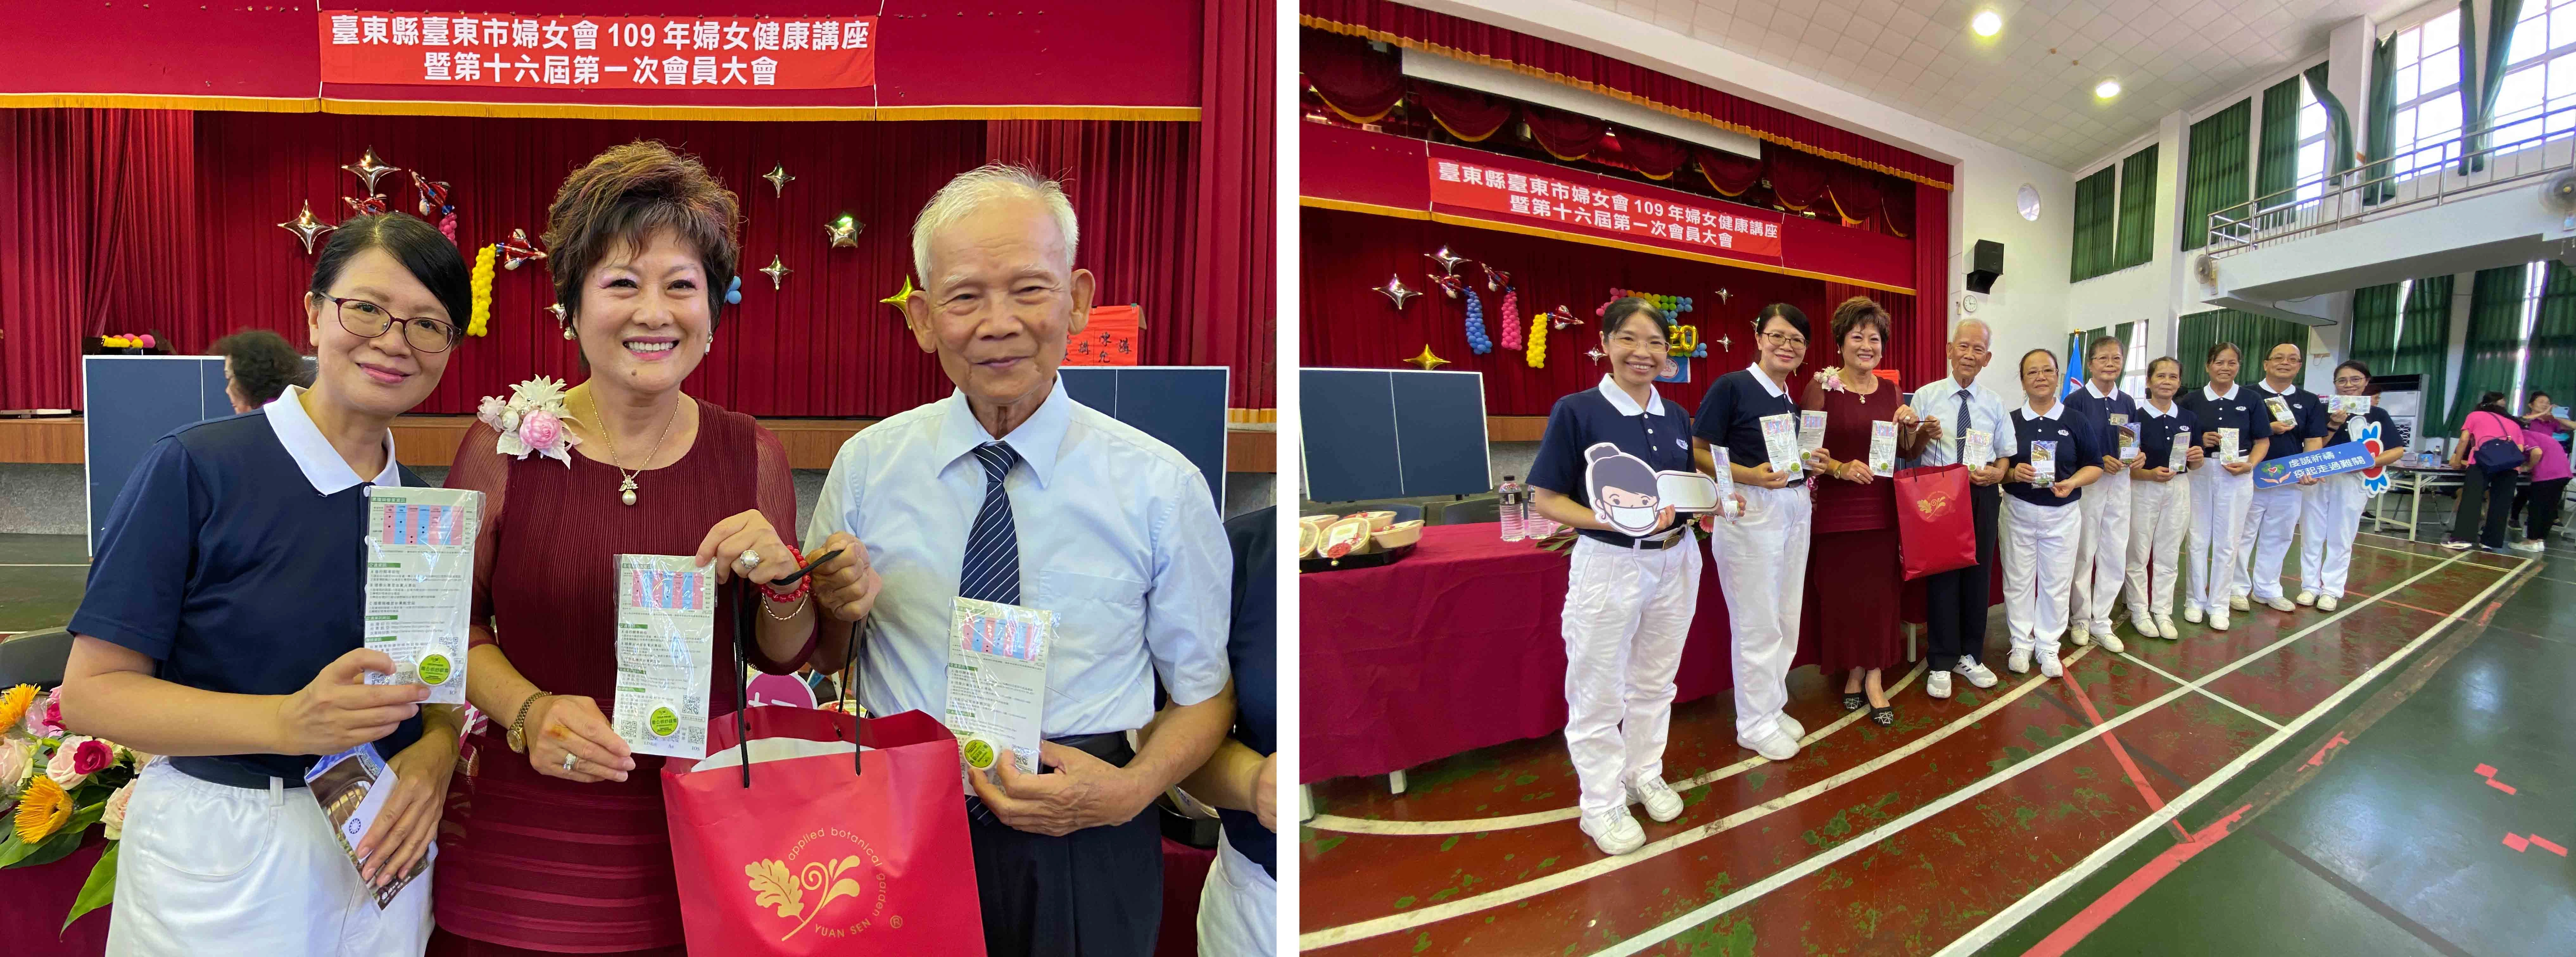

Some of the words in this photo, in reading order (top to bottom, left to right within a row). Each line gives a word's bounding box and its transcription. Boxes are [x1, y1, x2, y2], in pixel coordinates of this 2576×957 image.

[331, 15, 599, 50] 臺東縣臺東市婦女會
[608, 23, 655, 47] 109
[663, 20, 869, 51] 年婦女健康講座
[424, 52, 778, 85] 暨第十六屆第一次會員大會
[1438, 162, 1629, 212] 臺東縣臺東市婦女會
[1635, 199, 1663, 216] 109
[1668, 204, 1777, 238] 年婦女健康講座
[1510, 195, 1733, 248] 暨第十六屆第一次會員大會
[2293, 456, 2366, 478] 疫起走過難關
[788, 828, 825, 860] applied
[831, 827, 883, 866] botanical
[872, 873, 886, 916] garden
[815, 924, 845, 937] YUAN
[850, 918, 872, 935] SEN
